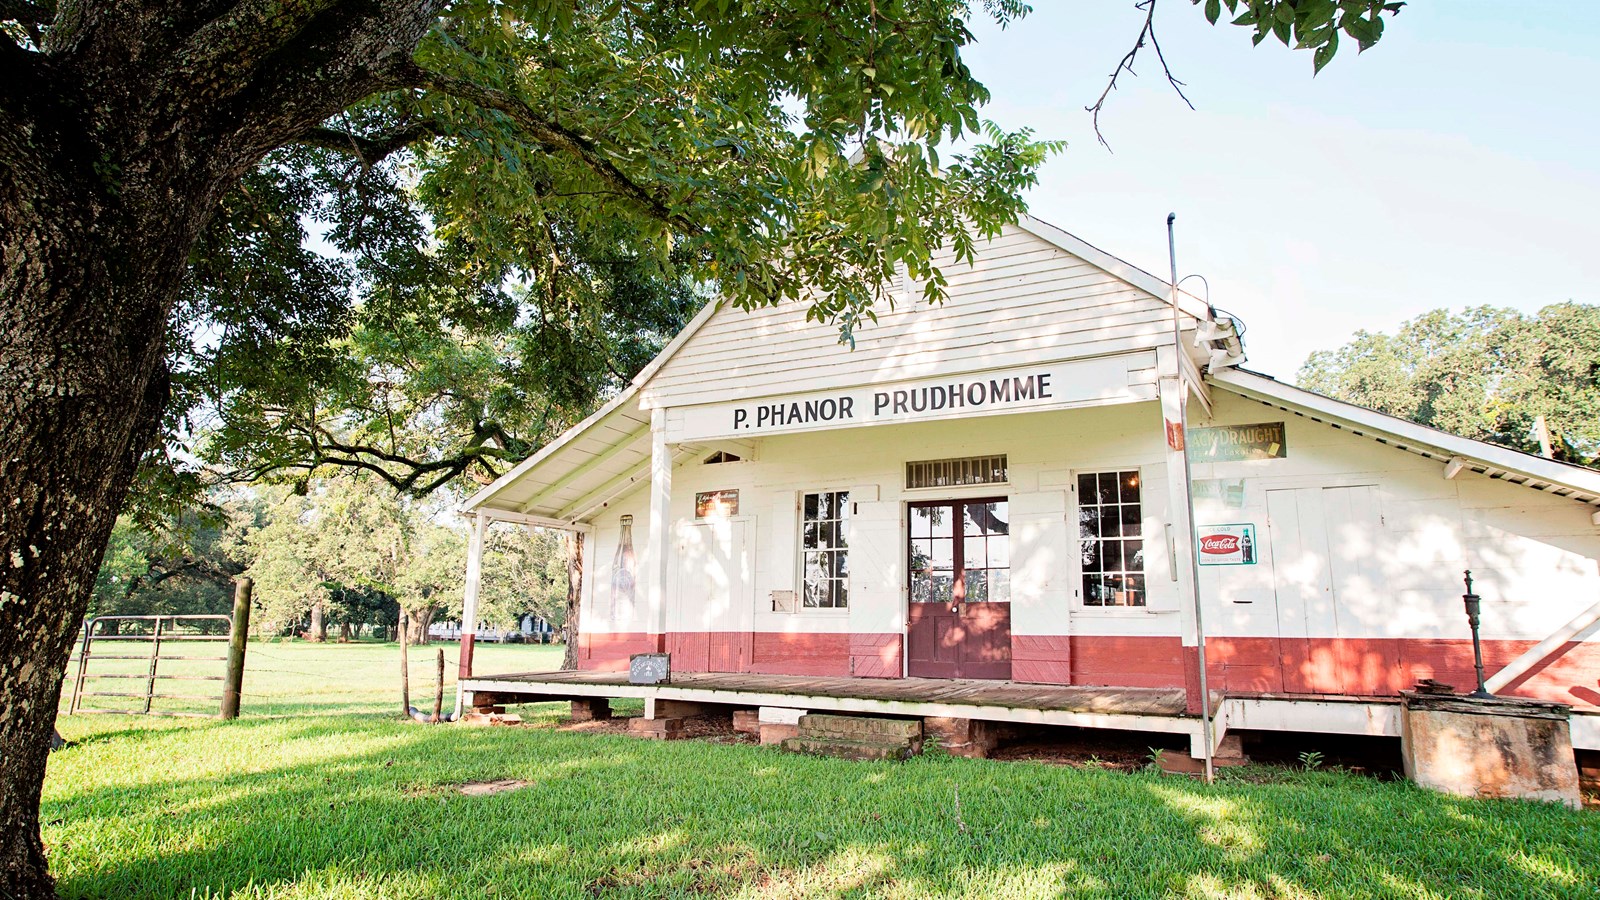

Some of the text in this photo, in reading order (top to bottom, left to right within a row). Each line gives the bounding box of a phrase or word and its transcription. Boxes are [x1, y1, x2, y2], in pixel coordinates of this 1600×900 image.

[733, 373, 1053, 430] P. PHANOR PRUDHOMME
[1188, 427, 1281, 448] ACK DRAUGHT
[1204, 538, 1236, 550] Coca-Cola
